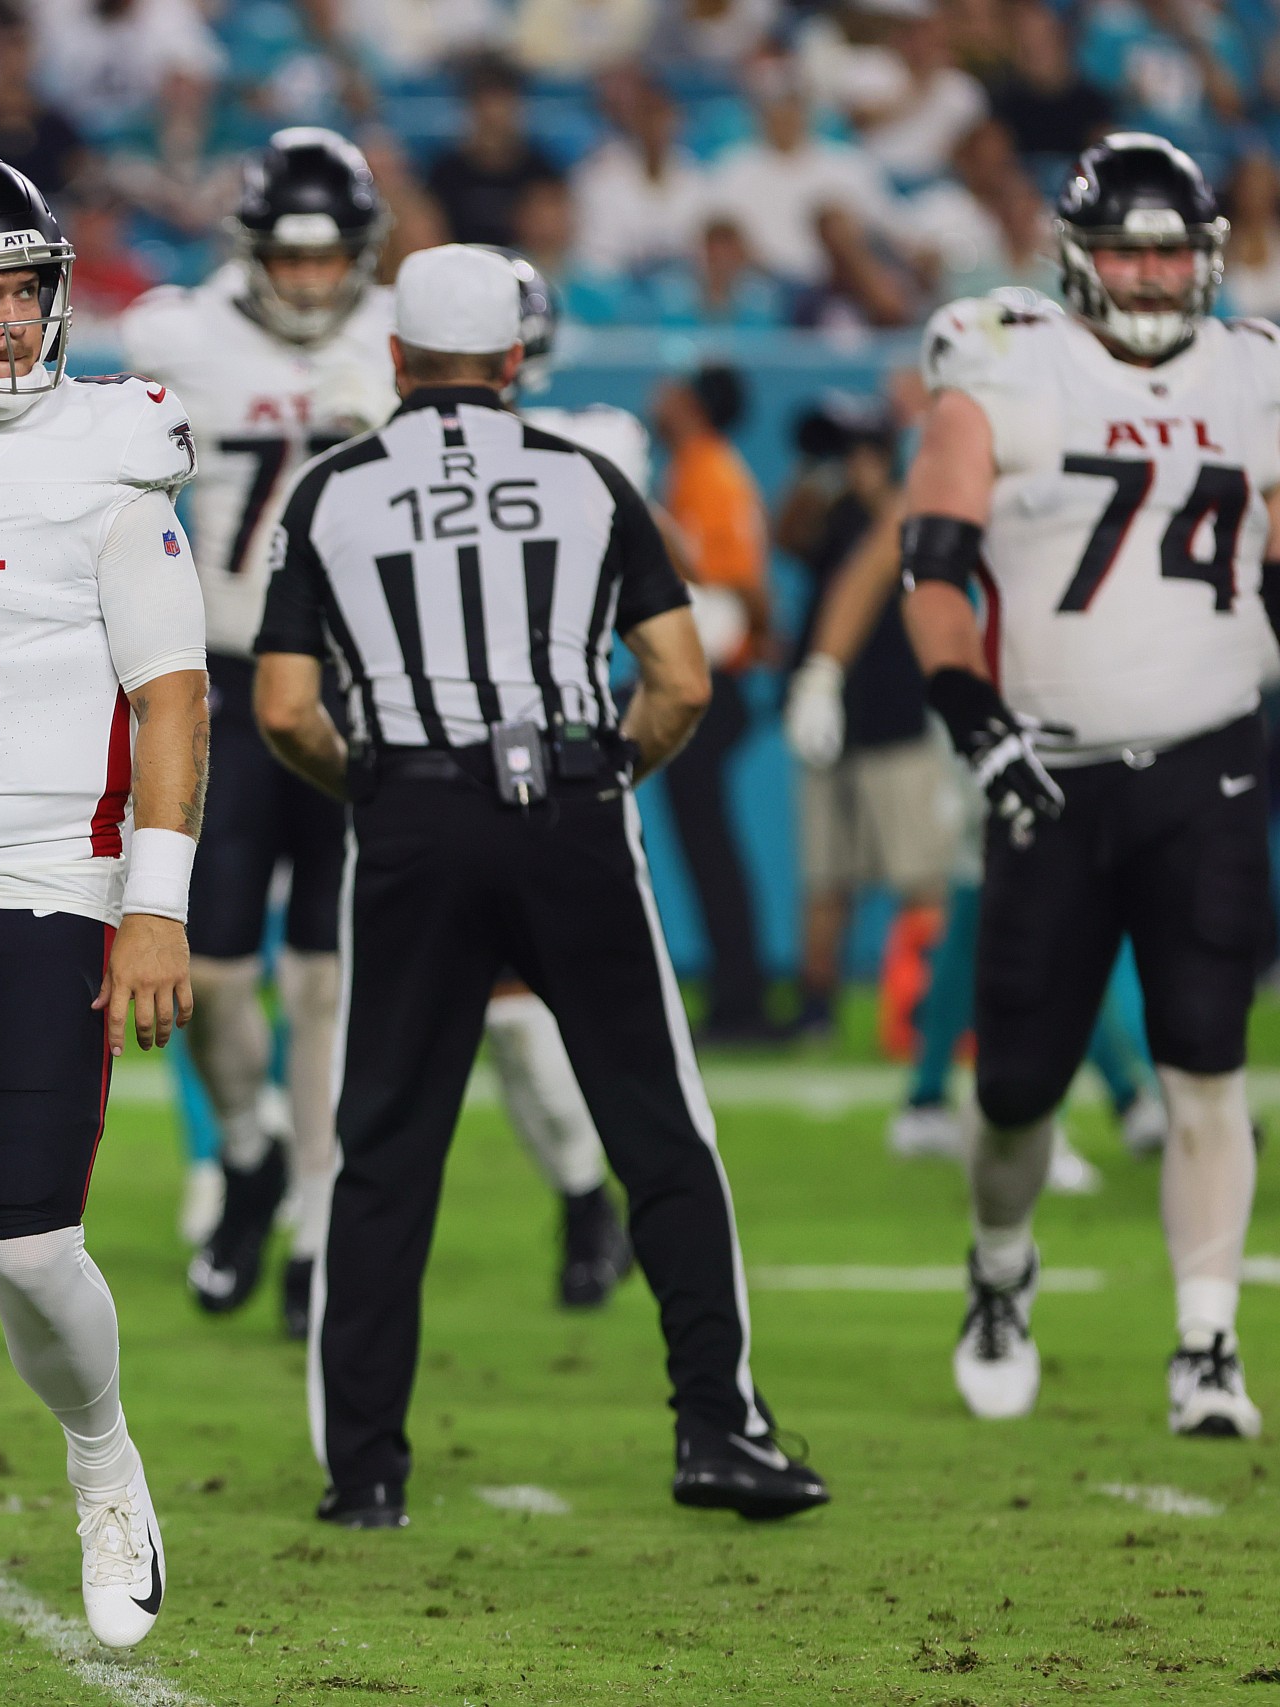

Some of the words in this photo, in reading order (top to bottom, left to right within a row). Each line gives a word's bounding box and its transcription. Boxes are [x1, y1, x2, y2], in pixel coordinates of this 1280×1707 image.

[3, 233, 36, 247] ATL
[1104, 418, 1223, 453] ATL
[442, 452, 477, 479] R
[218, 436, 356, 574] 7
[390, 480, 541, 542] 126
[1056, 455, 1250, 613] 74
